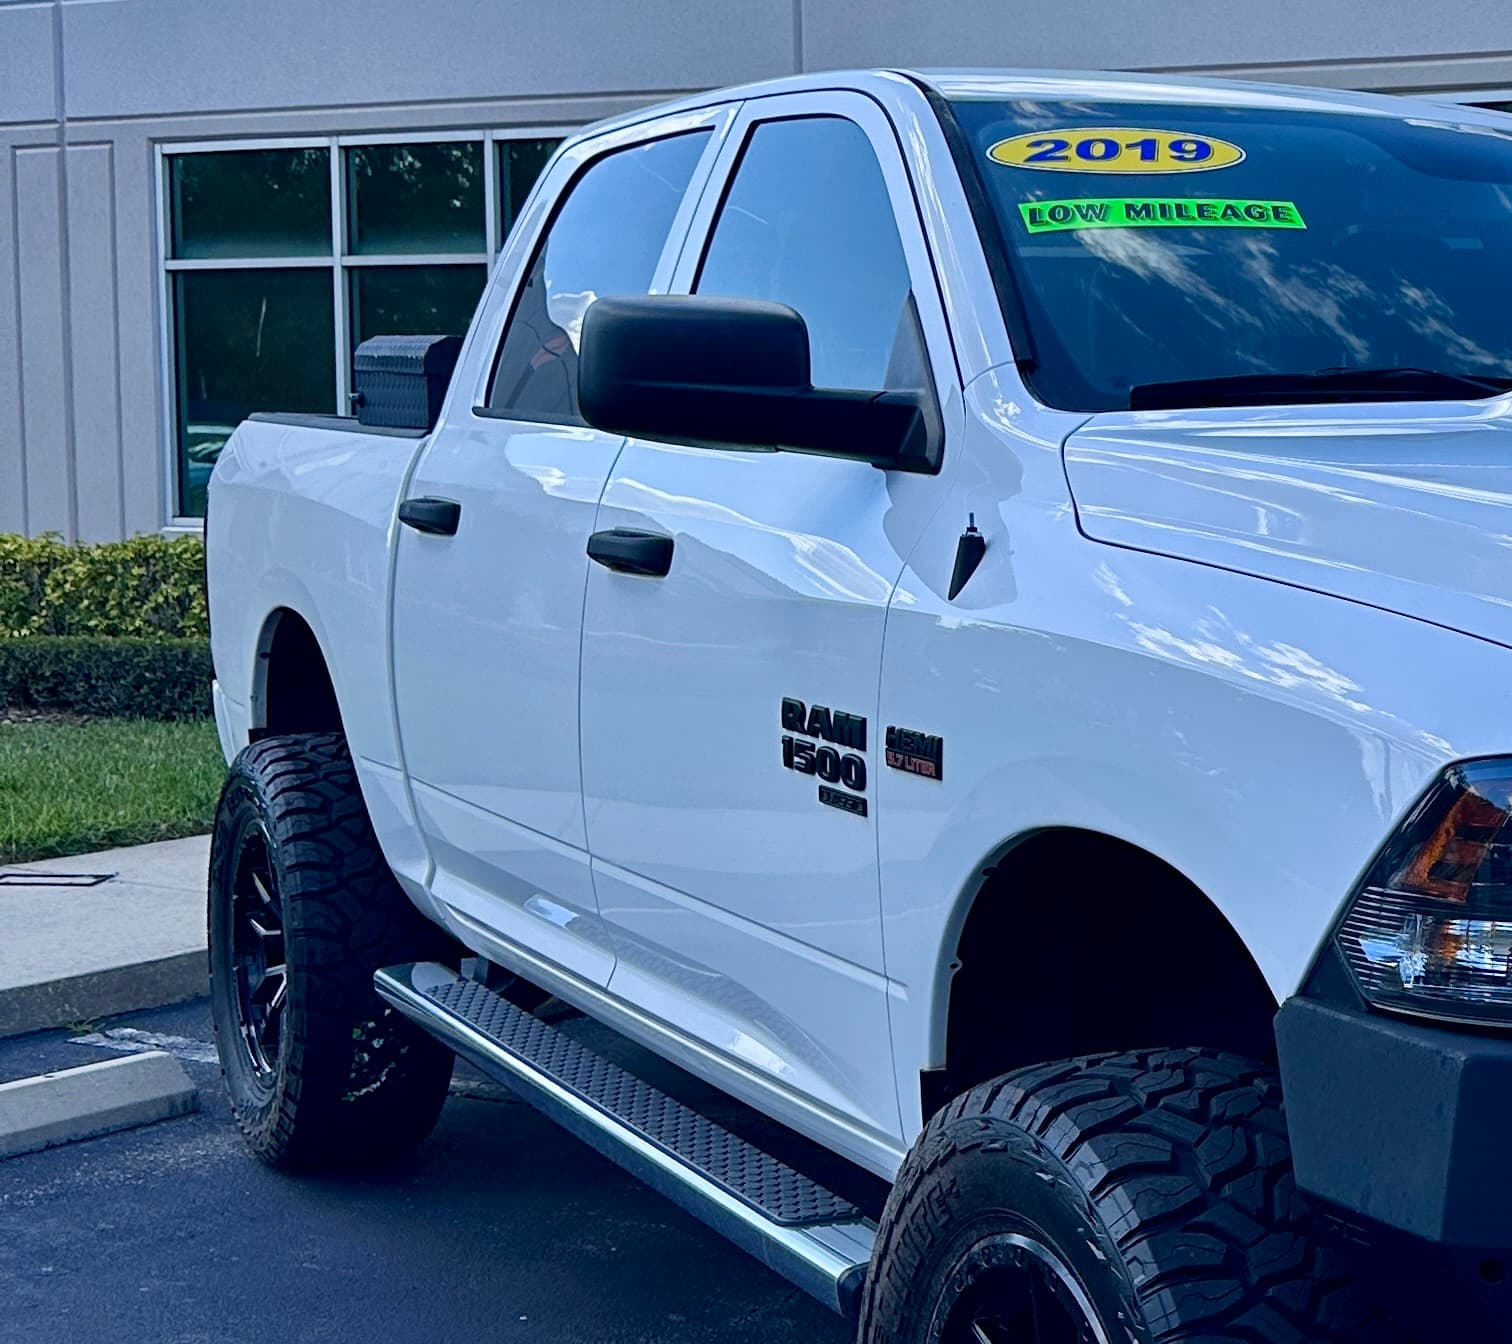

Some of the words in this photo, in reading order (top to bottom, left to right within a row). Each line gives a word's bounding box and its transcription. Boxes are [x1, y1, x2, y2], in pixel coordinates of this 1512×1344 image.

[1023, 138, 1215, 164] 2019
[1028, 203, 1108, 226] LOW
[1124, 202, 1297, 223] MILEAGE
[781, 696, 867, 752] RAM
[886, 725, 943, 761] HEMI
[781, 735, 867, 791] 1500
